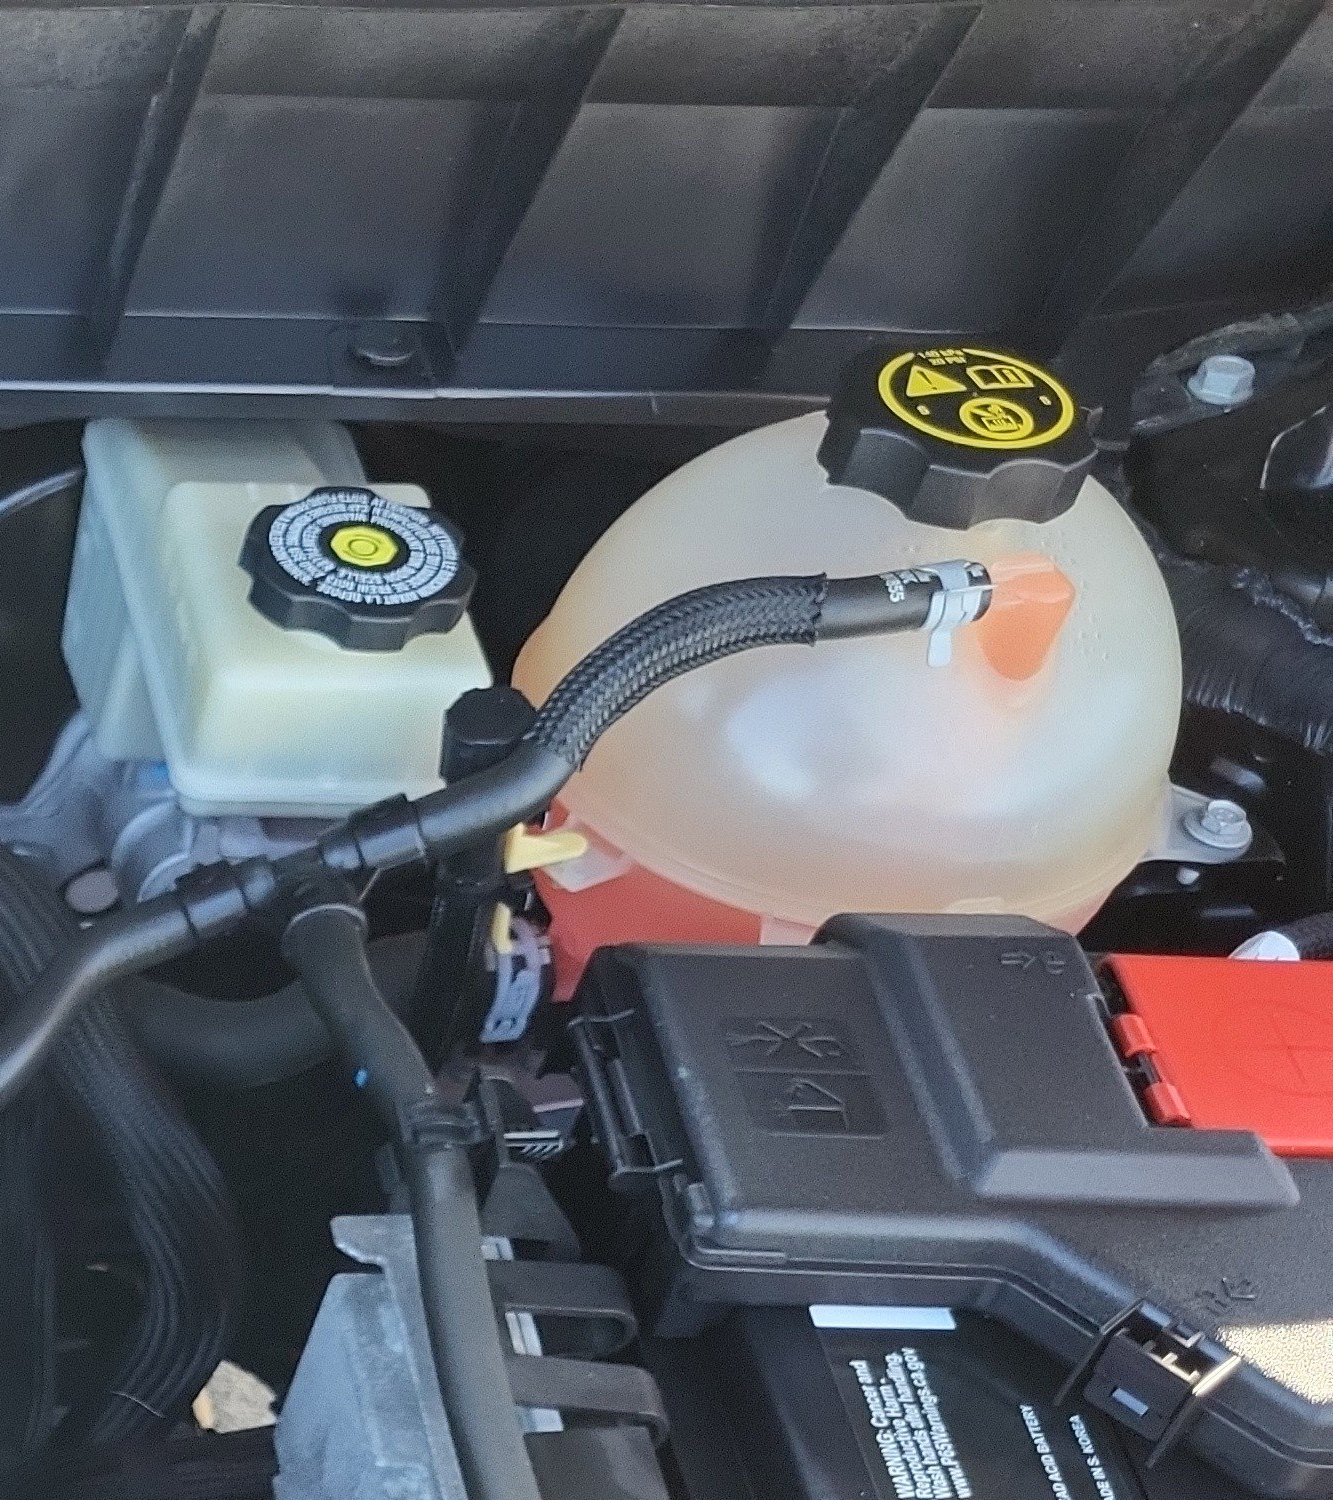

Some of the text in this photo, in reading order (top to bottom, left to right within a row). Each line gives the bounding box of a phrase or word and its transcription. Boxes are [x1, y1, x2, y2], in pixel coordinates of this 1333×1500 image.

[880, 1385, 903, 1417] Harm
[901, 1403, 925, 1429] after
[848, 1360, 917, 1498] WARNING: Cancer and
[899, 1347, 973, 1498] www.P65Warnings.ca.gov
[1018, 1404, 1051, 1453] BATTERY
[1067, 1414, 1094, 1453] KOREA
[889, 1419, 935, 1498] Reproductive
[912, 1430, 939, 1465] hands
[1084, 1454, 1100, 1466] S.
[924, 1466, 953, 1498] Wash
[1039, 1453, 1062, 1481] ACID
[1089, 1466, 1106, 1479] IN
